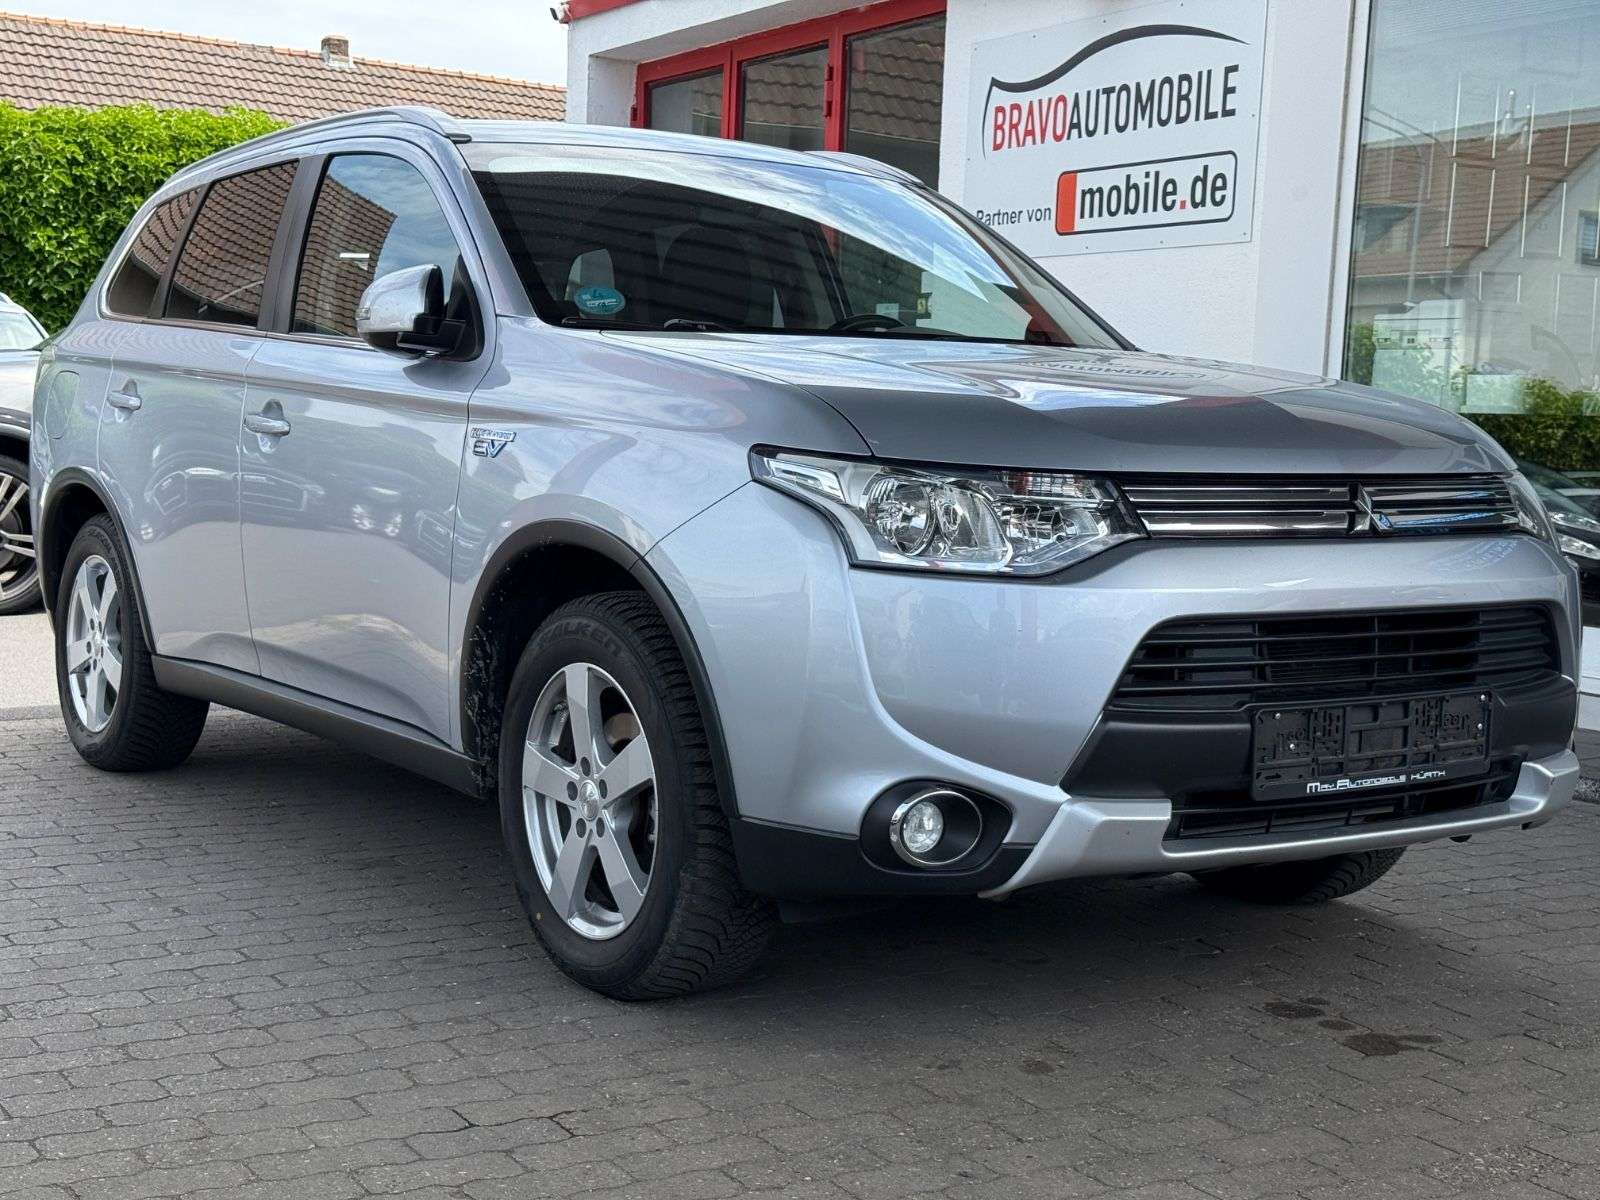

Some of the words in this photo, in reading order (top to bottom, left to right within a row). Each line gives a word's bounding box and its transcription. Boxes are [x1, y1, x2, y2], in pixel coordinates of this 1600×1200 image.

[992, 64, 1239, 151] BRAVOAUTOMOBILE
[976, 208, 1023, 226] Partner
[1027, 206, 1052, 222] von
[1079, 165, 1227, 219] mobile.de
[472, 439, 508, 458] EV
